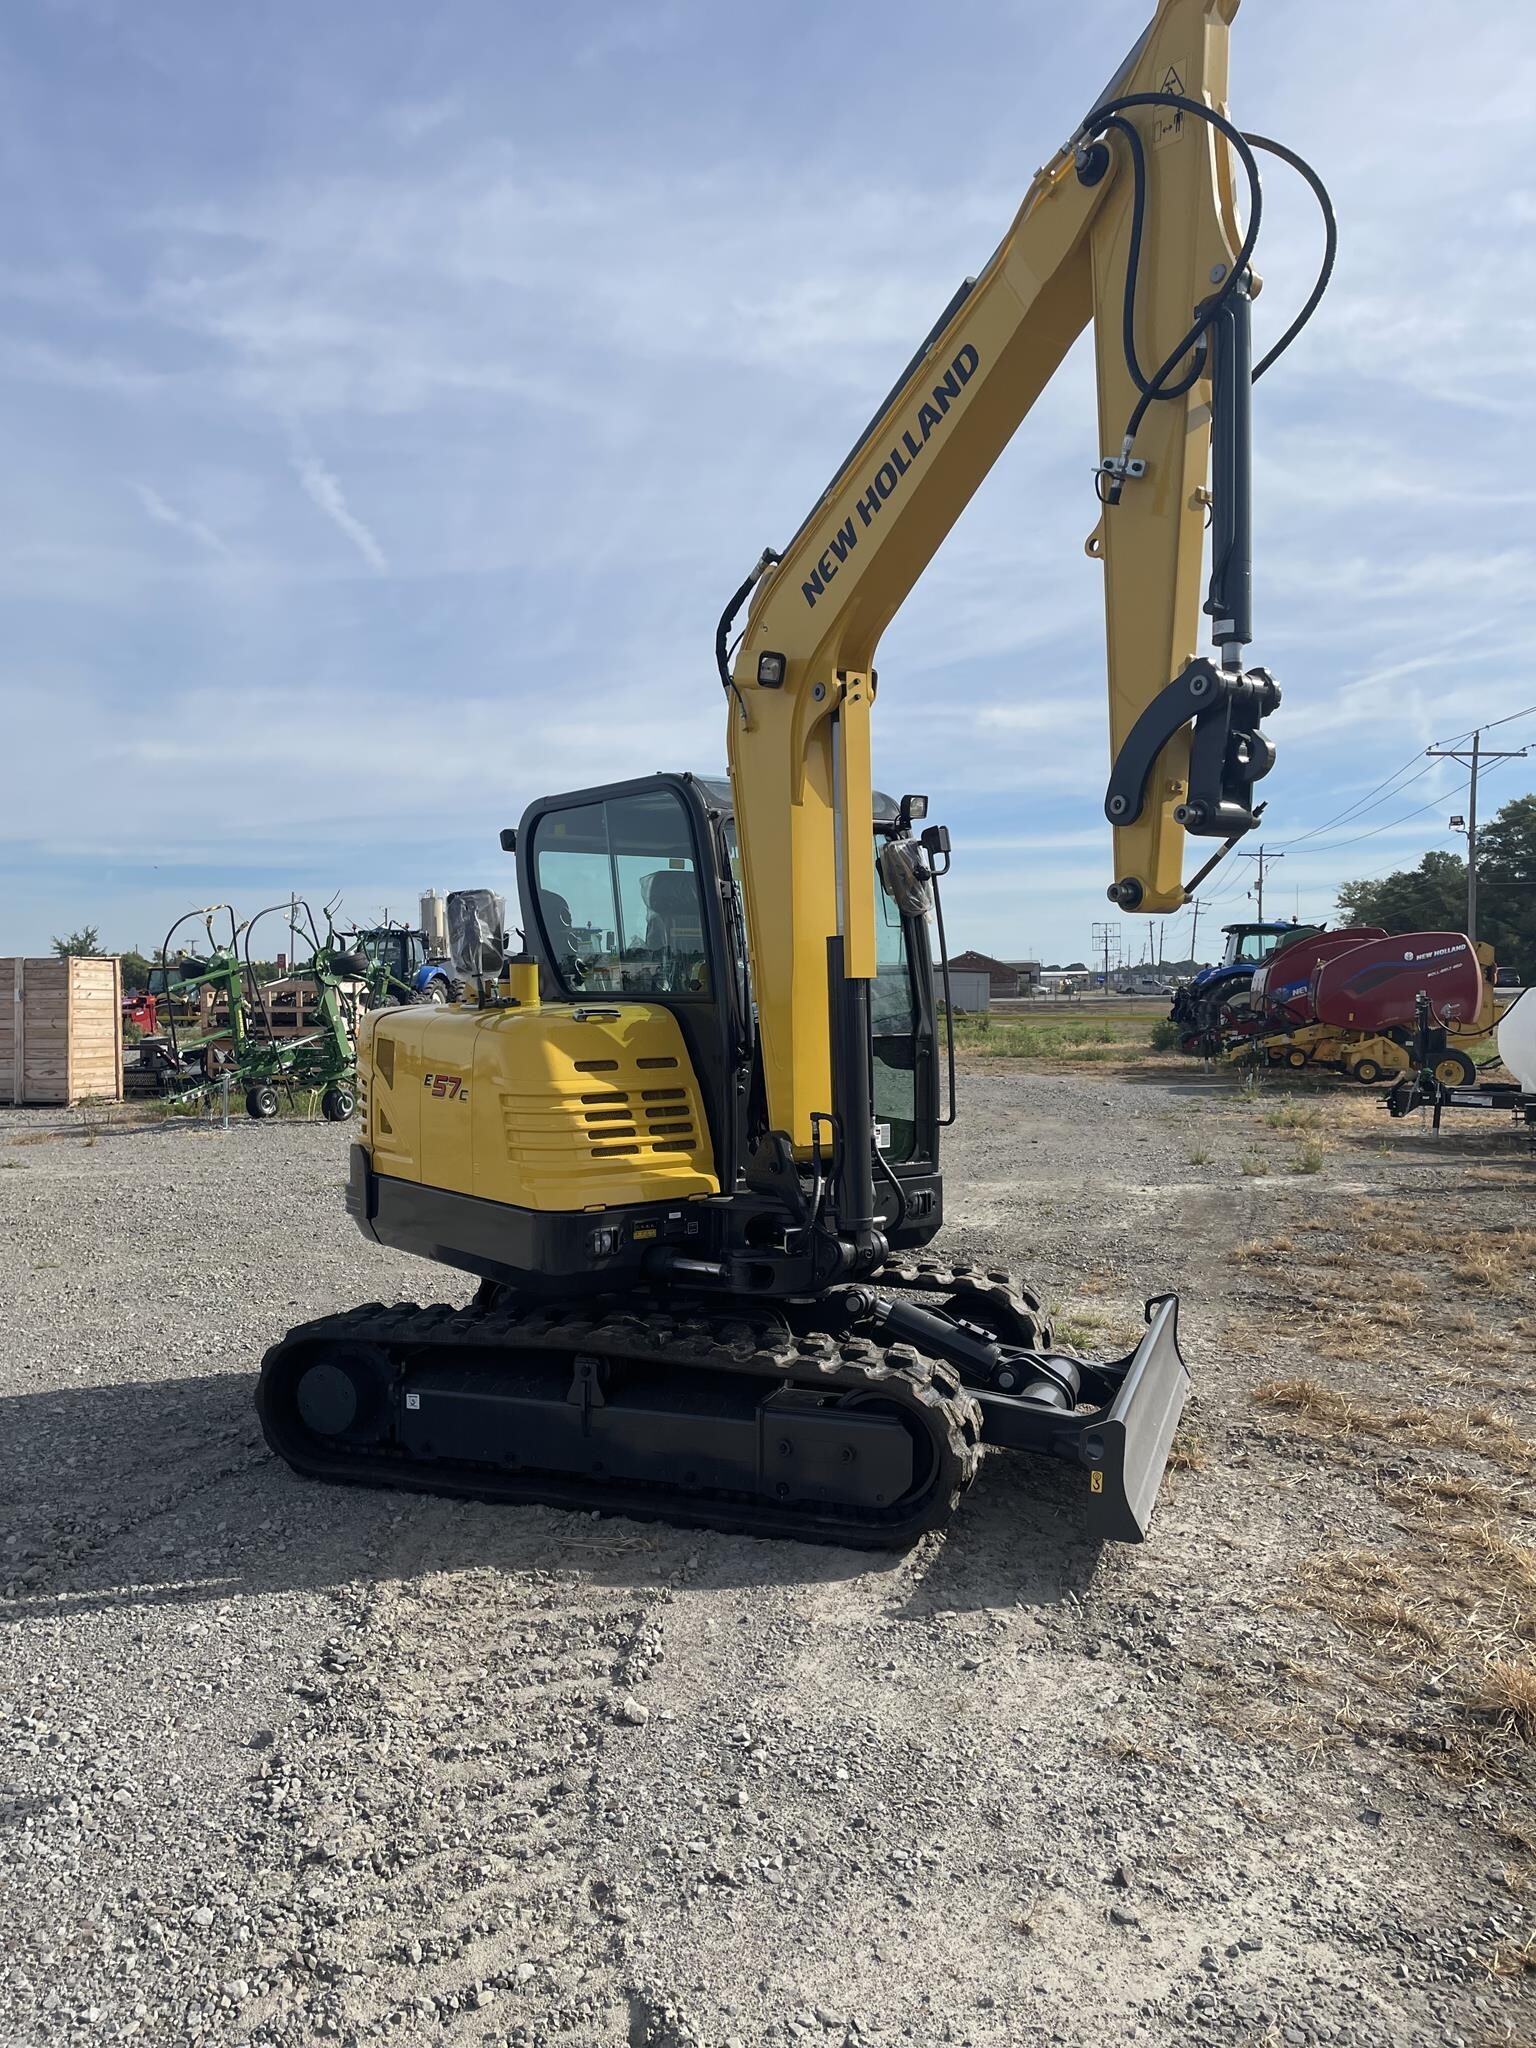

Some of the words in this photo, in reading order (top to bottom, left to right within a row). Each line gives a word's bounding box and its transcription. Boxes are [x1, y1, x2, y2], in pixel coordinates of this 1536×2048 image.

[801, 517, 858, 608] NEW
[856, 343, 979, 527] HOLLAND
[1416, 951, 1433, 961] NEW
[1433, 943, 1467, 957] HOLLAND
